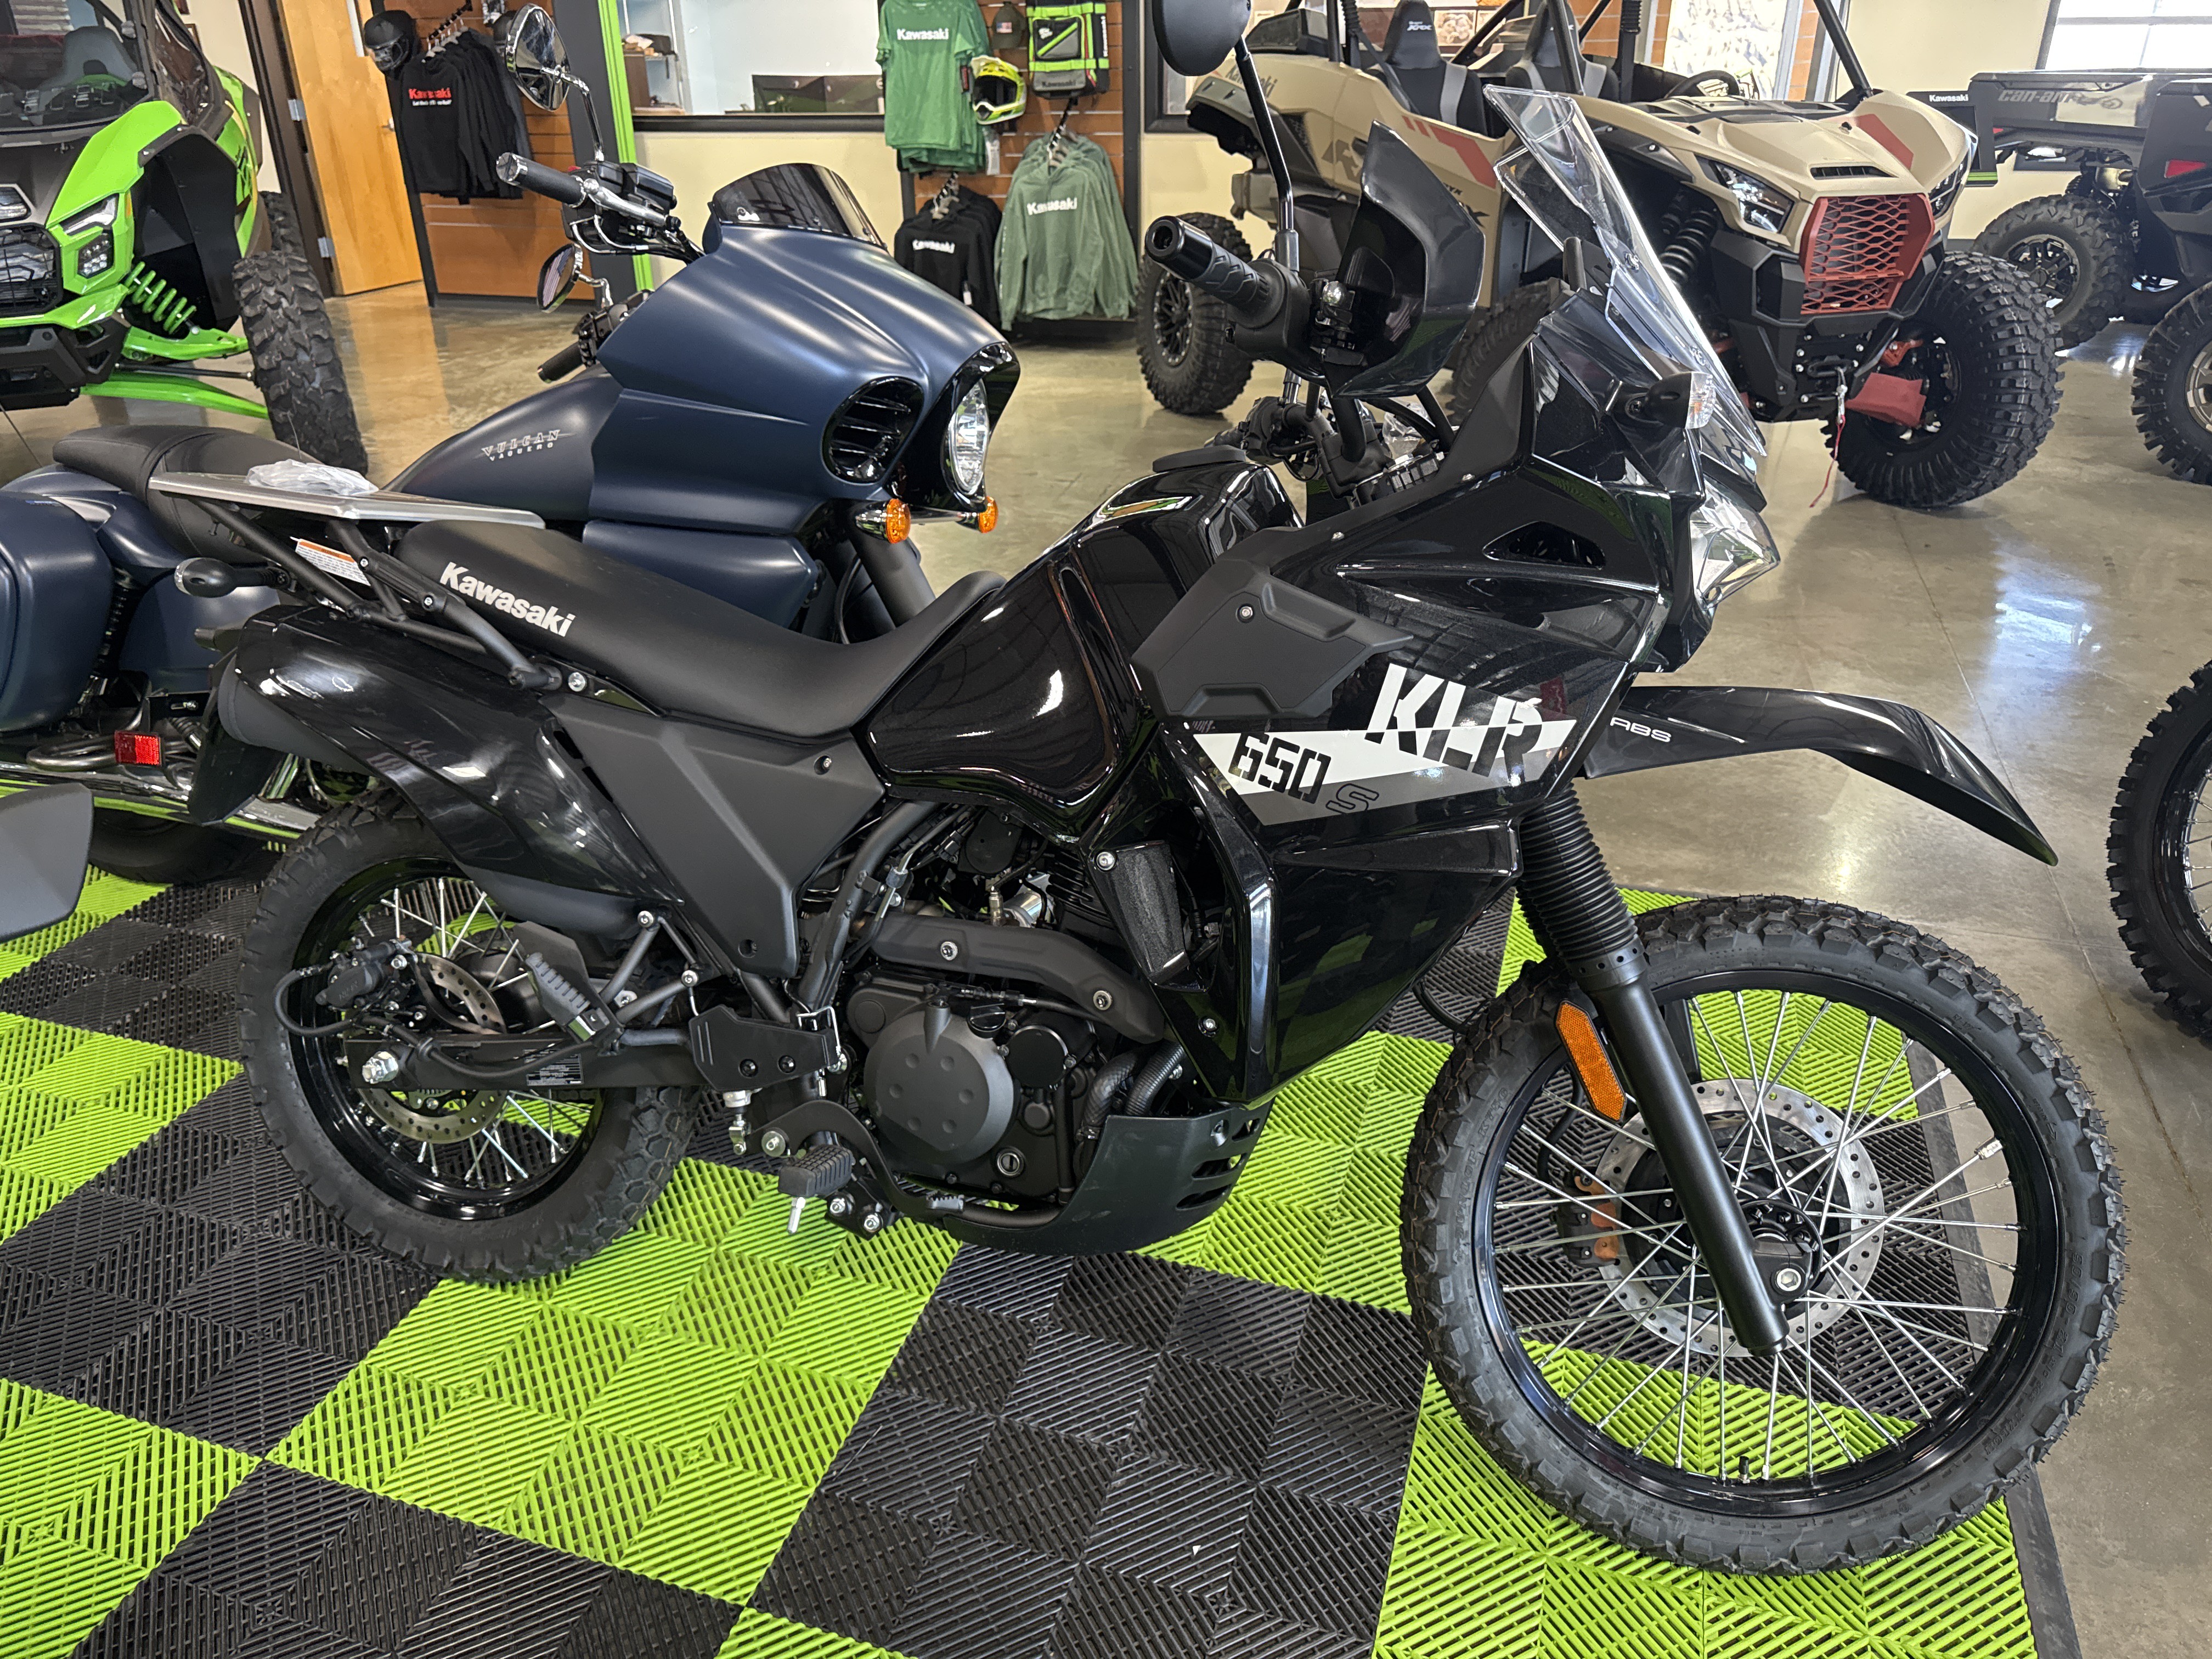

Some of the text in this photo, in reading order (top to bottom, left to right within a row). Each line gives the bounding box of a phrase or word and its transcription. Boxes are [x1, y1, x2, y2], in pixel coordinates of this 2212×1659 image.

[896, 27, 949, 41] Kawasaki
[1928, 93, 1969, 103] Kawasaki
[1026, 196, 1079, 216] Kawasaki
[481, 429, 561, 457] VULCAN
[489, 441, 554, 461] VAQUERO
[439, 561, 577, 637] Kawasaki
[1364, 663, 1543, 785] KLR
[1610, 716, 1672, 742] ABS
[1228, 732, 1380, 814] 650 S
